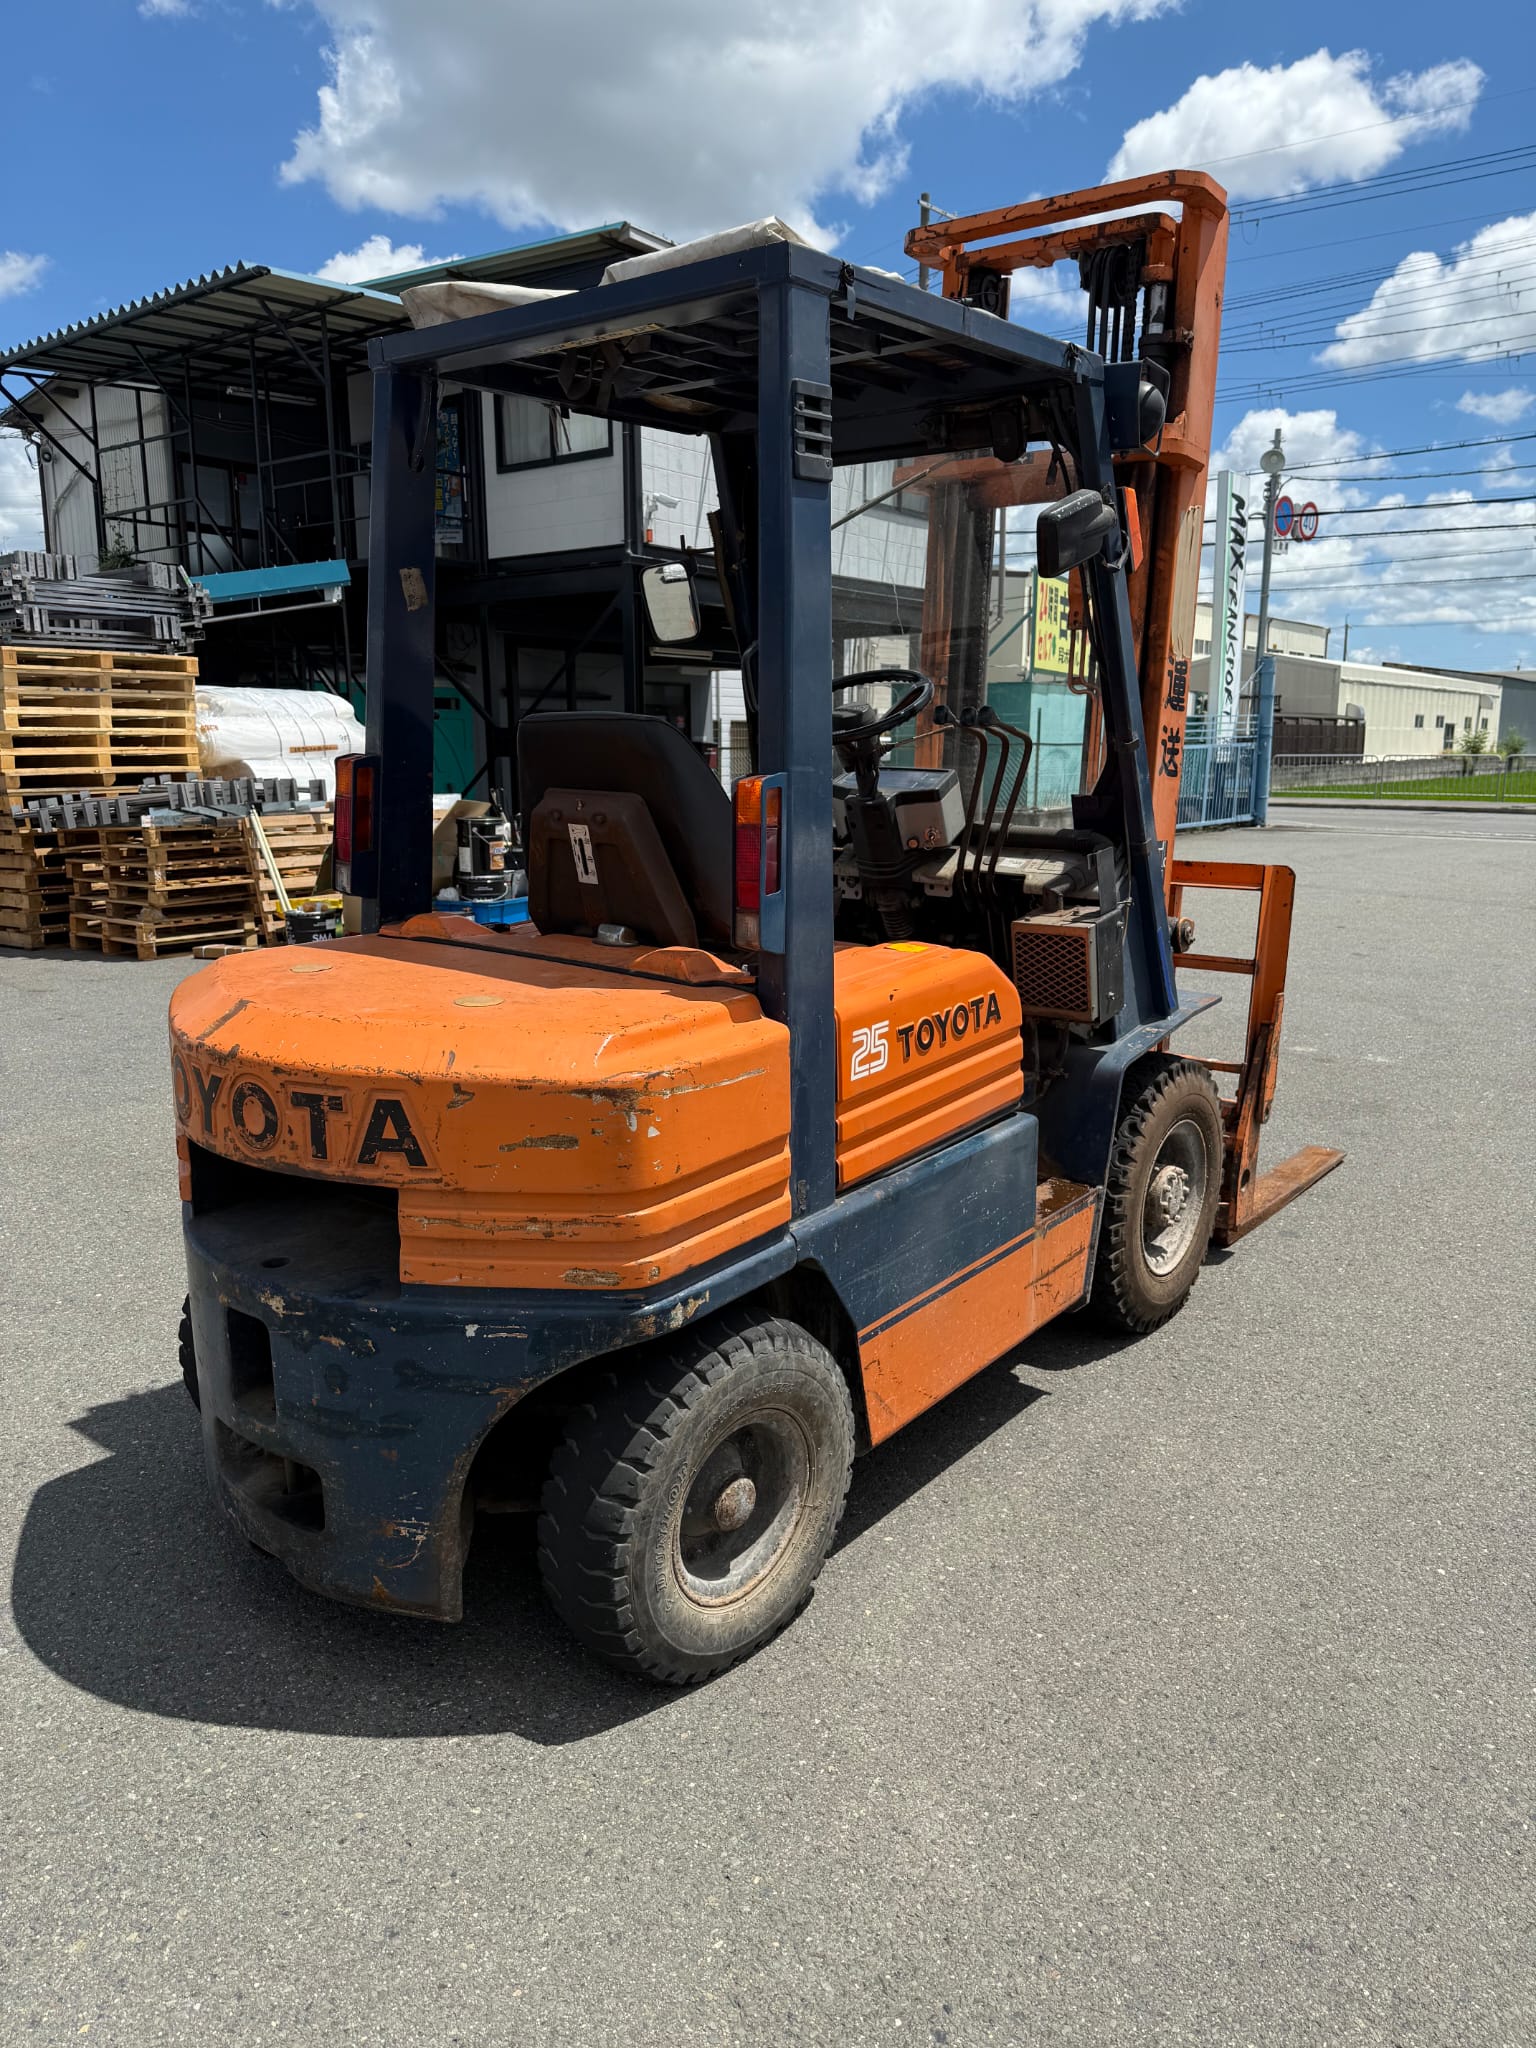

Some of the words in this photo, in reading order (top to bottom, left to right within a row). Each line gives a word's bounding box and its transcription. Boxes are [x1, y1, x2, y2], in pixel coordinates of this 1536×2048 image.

[1303, 513, 1315, 531] 40
[851, 1020, 890, 1081] 25
[897, 990, 1001, 1062] TOYOTA
